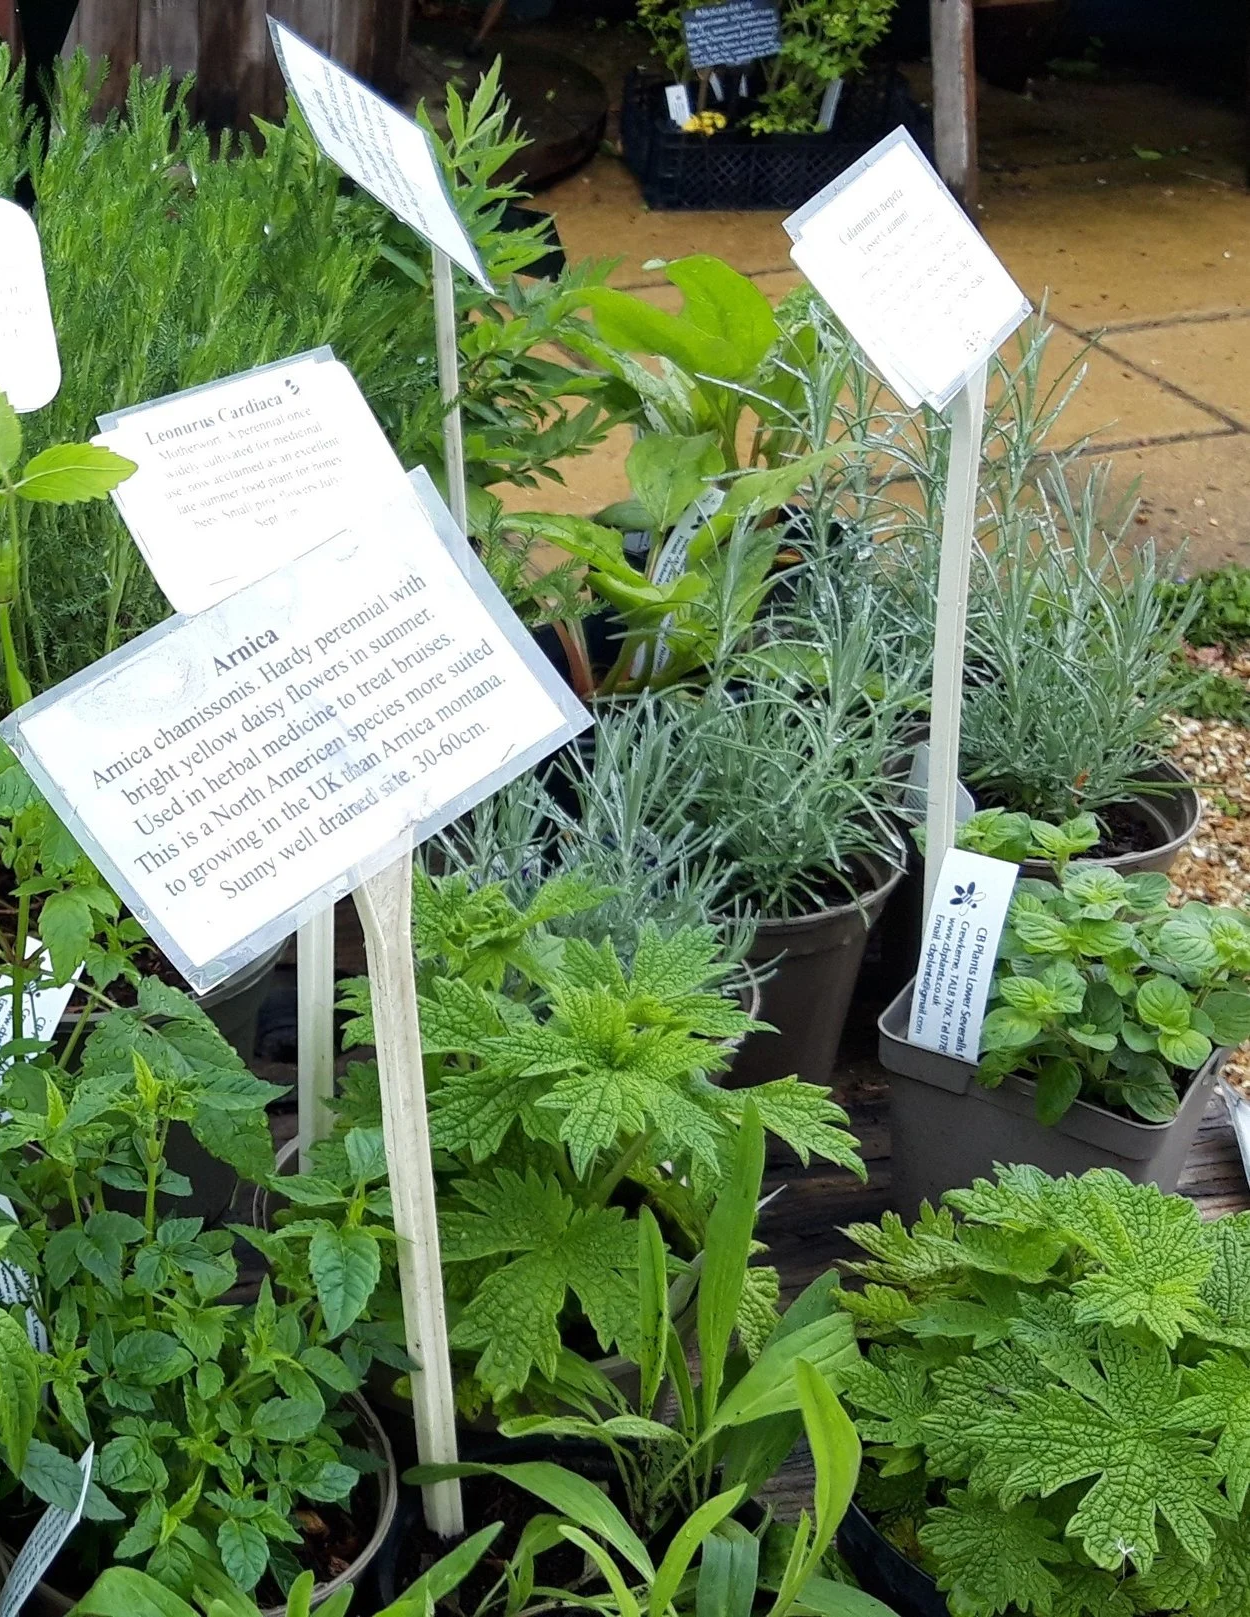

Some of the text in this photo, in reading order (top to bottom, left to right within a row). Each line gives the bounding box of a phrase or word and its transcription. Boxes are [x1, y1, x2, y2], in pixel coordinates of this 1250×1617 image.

[144, 394, 283, 446] Leonurus Cardiaca
[237, 414, 286, 440] perennial
[287, 407, 312, 422] once
[255, 440, 270, 451] for
[272, 420, 323, 446] medicinal
[213, 460, 265, 485] acclaimed
[267, 459, 278, 468] as
[279, 453, 293, 464] an
[294, 437, 340, 459] excellent
[199, 489, 239, 508] summer
[294, 466, 309, 477] for
[212, 629, 280, 678] Arnica
[92, 574, 427, 790] Arnica chamissonis. Hardy perennial with
[120, 608, 435, 806] bright yellow daisy flowers in summer.
[132, 633, 456, 836] Used in herbal medicine to treat bruises.
[133, 637, 495, 875] This is a North American species more suited
[164, 674, 506, 897] to growing in the UK than Arnica montana.
[219, 722, 490, 900] Sunny well drained site. 30-60cm.
[950, 920, 970, 972] Crewkerne,
[968, 943, 985, 976] Plants
[975, 927, 988, 943] CB
[915, 914, 946, 1035] Email. cbplants@gmail.com
[931, 917, 956, 1007] www.cbplants.co.uk
[946, 974, 960, 997] TA18
[962, 977, 978, 1010] Lower
[940, 1021, 951, 1035] Tel
[955, 1010, 972, 1053] Severalls
